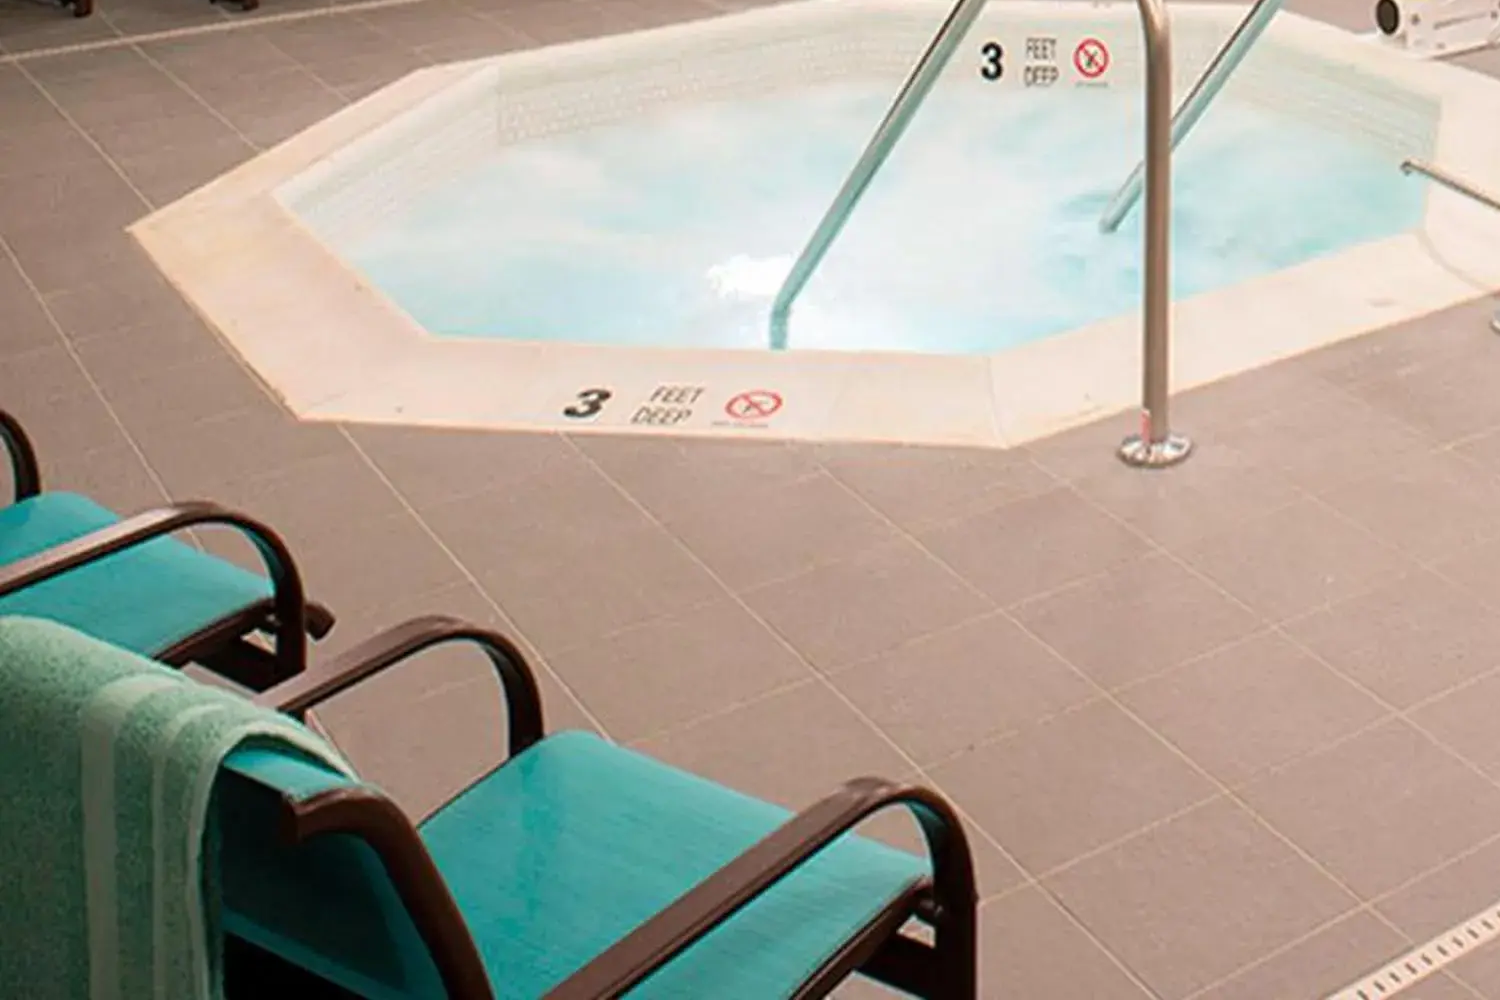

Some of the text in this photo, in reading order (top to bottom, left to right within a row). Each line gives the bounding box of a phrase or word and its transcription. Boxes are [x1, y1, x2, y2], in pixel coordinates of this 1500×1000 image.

[1025, 37, 1057, 60] FEET
[981, 41, 1004, 81] 3
[1023, 65, 1059, 87] DEEP
[563, 387, 612, 419] 3
[650, 385, 705, 404] FEET
[630, 404, 693, 425] DEEP
